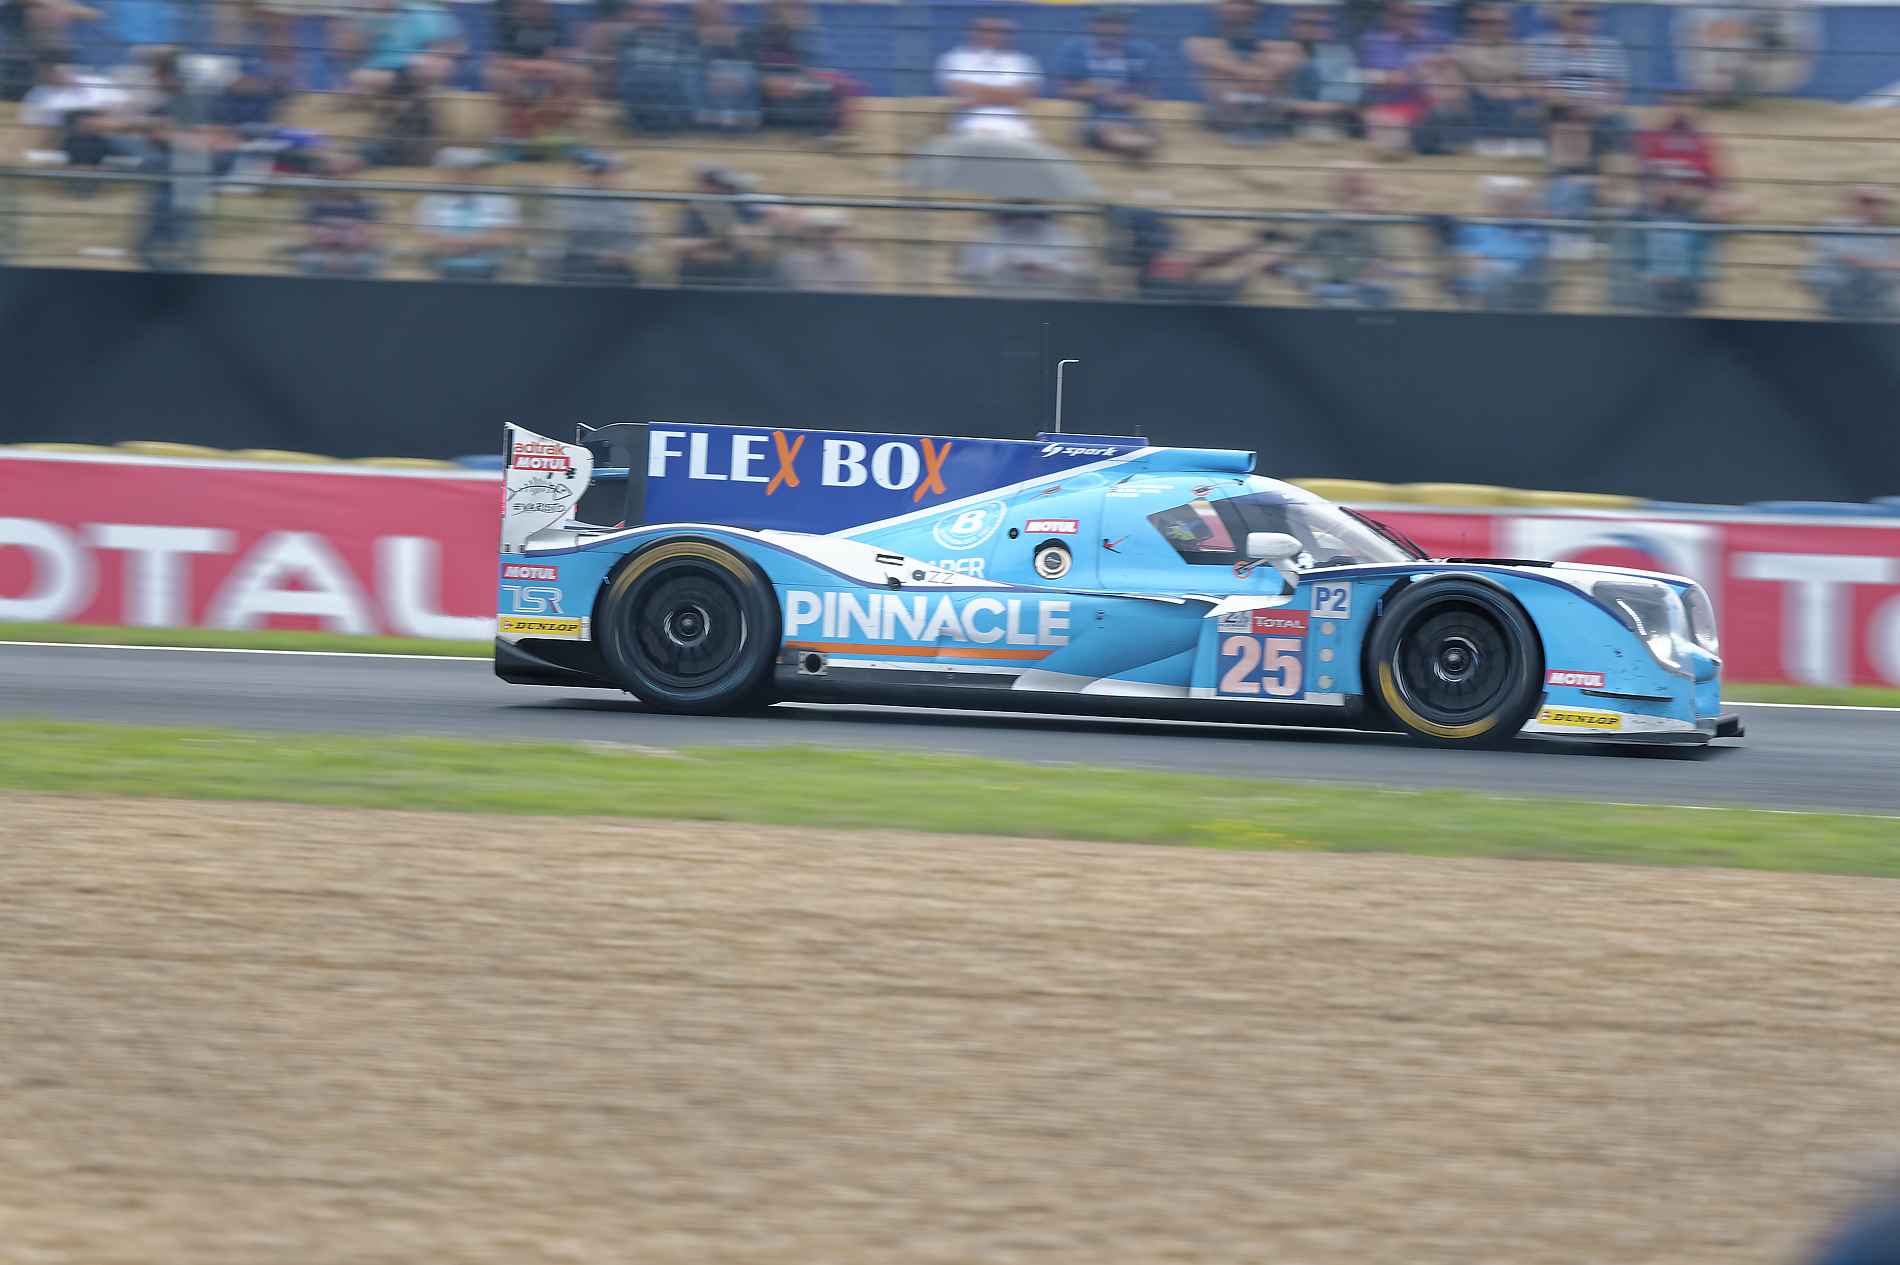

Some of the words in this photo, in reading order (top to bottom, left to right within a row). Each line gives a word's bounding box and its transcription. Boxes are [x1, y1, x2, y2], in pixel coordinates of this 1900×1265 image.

[515, 457, 566, 469] MOTUL
[648, 430, 804, 496] FLEX
[821, 437, 952, 503] BOX
[1026, 521, 1078, 533] MOTUL
[504, 566, 558, 579] MOTUL
[1316, 587, 1348, 612] P2
[784, 590, 1072, 646] PINNACLE
[1254, 616, 1307, 629] TOTAL
[514, 622, 579, 632] DUNLOP
[1220, 636, 1303, 696] 25
[1550, 672, 1603, 686] MOTUL
[1552, 713, 1618, 725] DUNLOP
